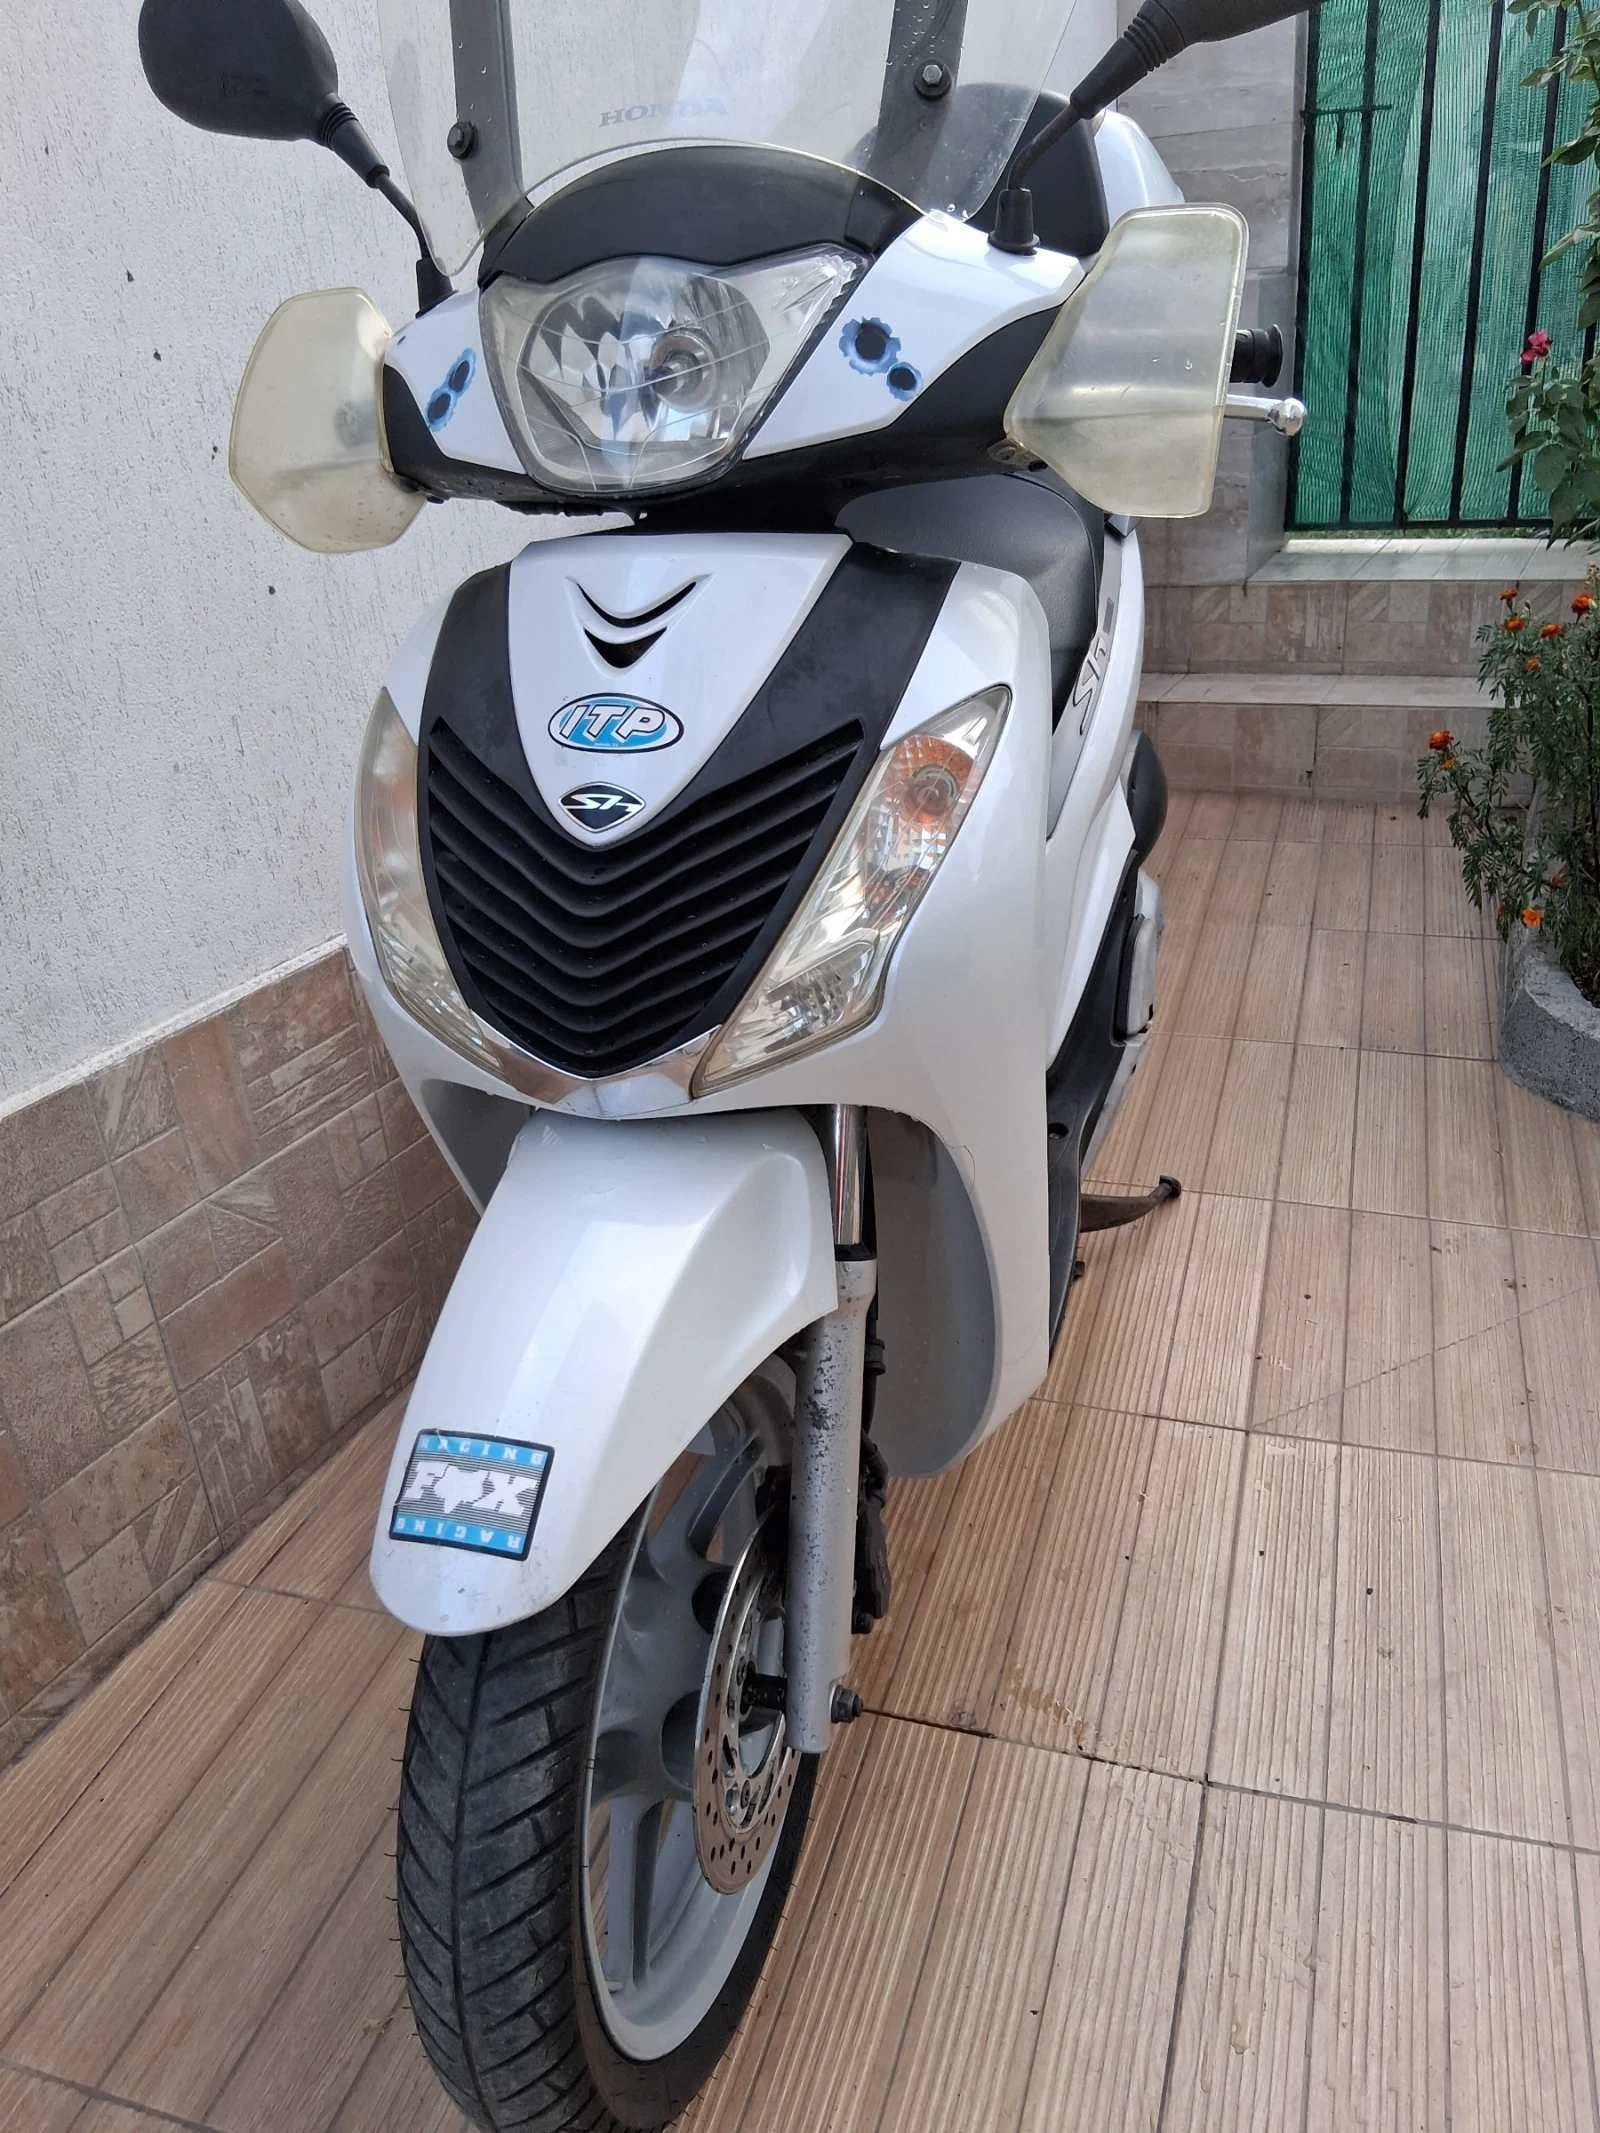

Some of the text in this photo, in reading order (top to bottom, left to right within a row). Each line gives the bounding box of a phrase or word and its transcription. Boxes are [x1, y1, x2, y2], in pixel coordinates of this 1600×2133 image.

[599, 98, 729, 127] HONDA
[559, 704, 666, 741] ITP
[418, 1438, 544, 1465] RACING
[403, 1461, 540, 1515] FOX
[396, 1517, 522, 1549] RACING
